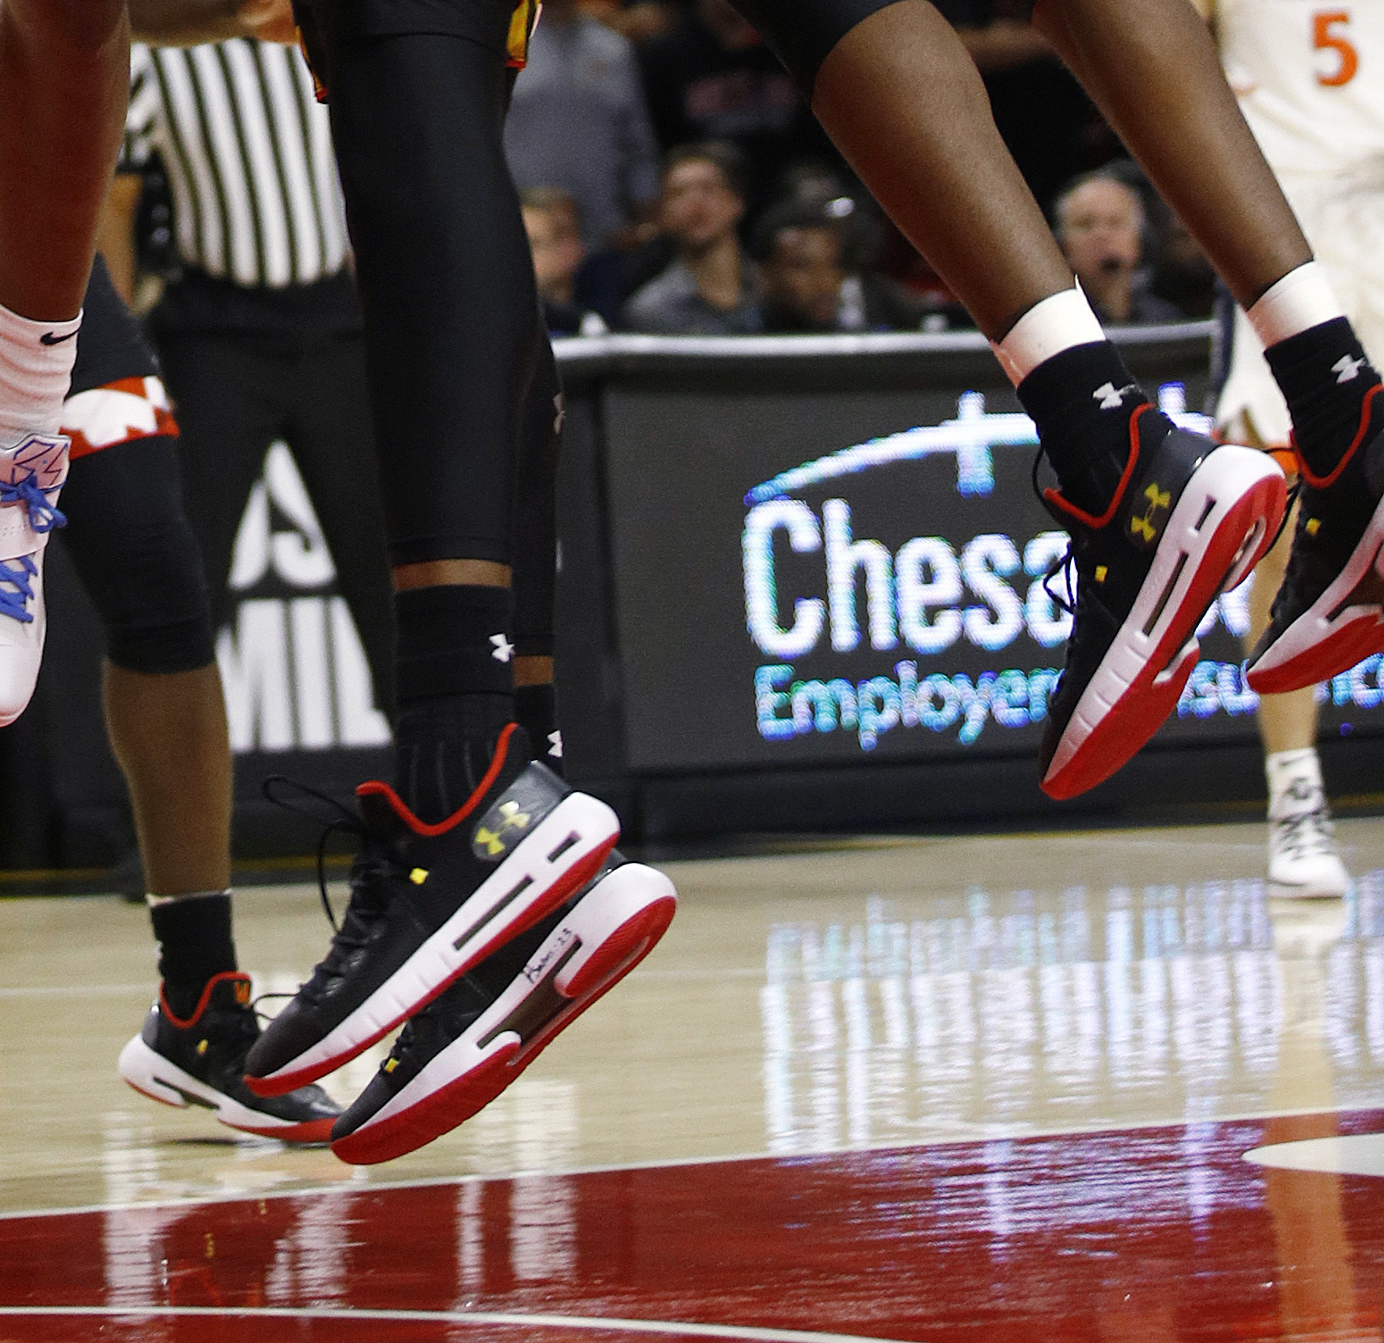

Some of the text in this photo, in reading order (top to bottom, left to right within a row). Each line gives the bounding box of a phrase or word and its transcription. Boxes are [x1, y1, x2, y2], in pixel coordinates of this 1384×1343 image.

[1310, 9, 1360, 88] 5
[743, 498, 1074, 657] Chesa
[754, 661, 1064, 751] Employer
